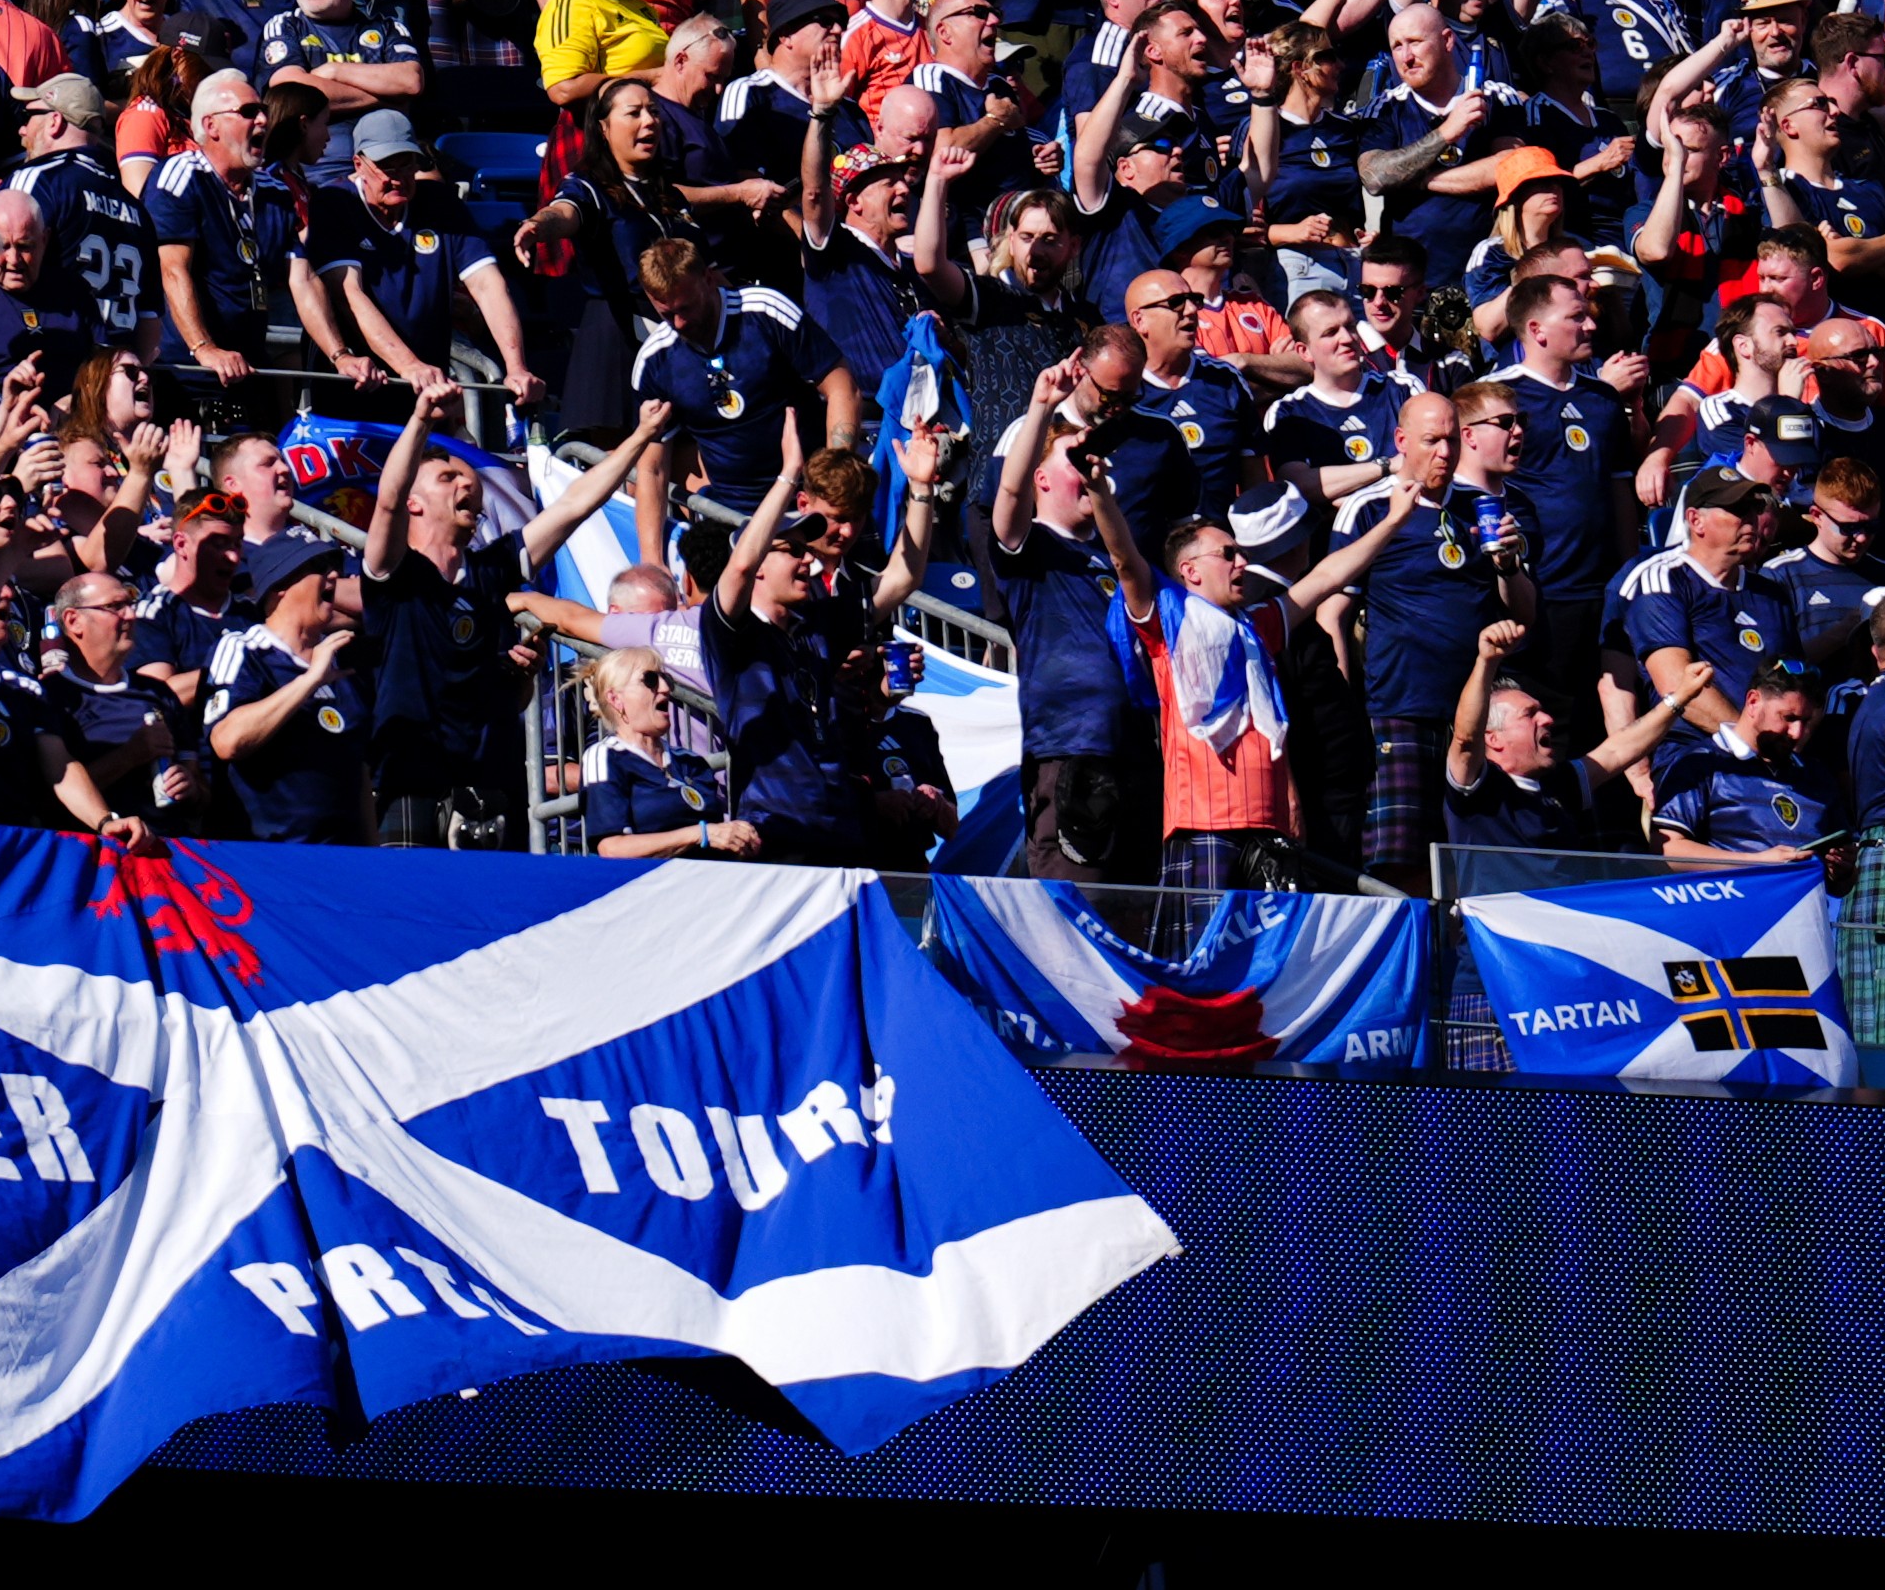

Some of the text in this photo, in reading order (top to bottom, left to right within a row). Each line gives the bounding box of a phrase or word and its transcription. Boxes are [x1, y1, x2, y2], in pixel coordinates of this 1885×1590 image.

[1622, 29, 1650, 60] 6
[83, 189, 142, 227] McLEAN
[76, 233, 144, 329] 23
[1652, 879, 1745, 906] WICK
[1508, 998, 1633, 1037] TARTAN
[1344, 1020, 1416, 1062] ARM
